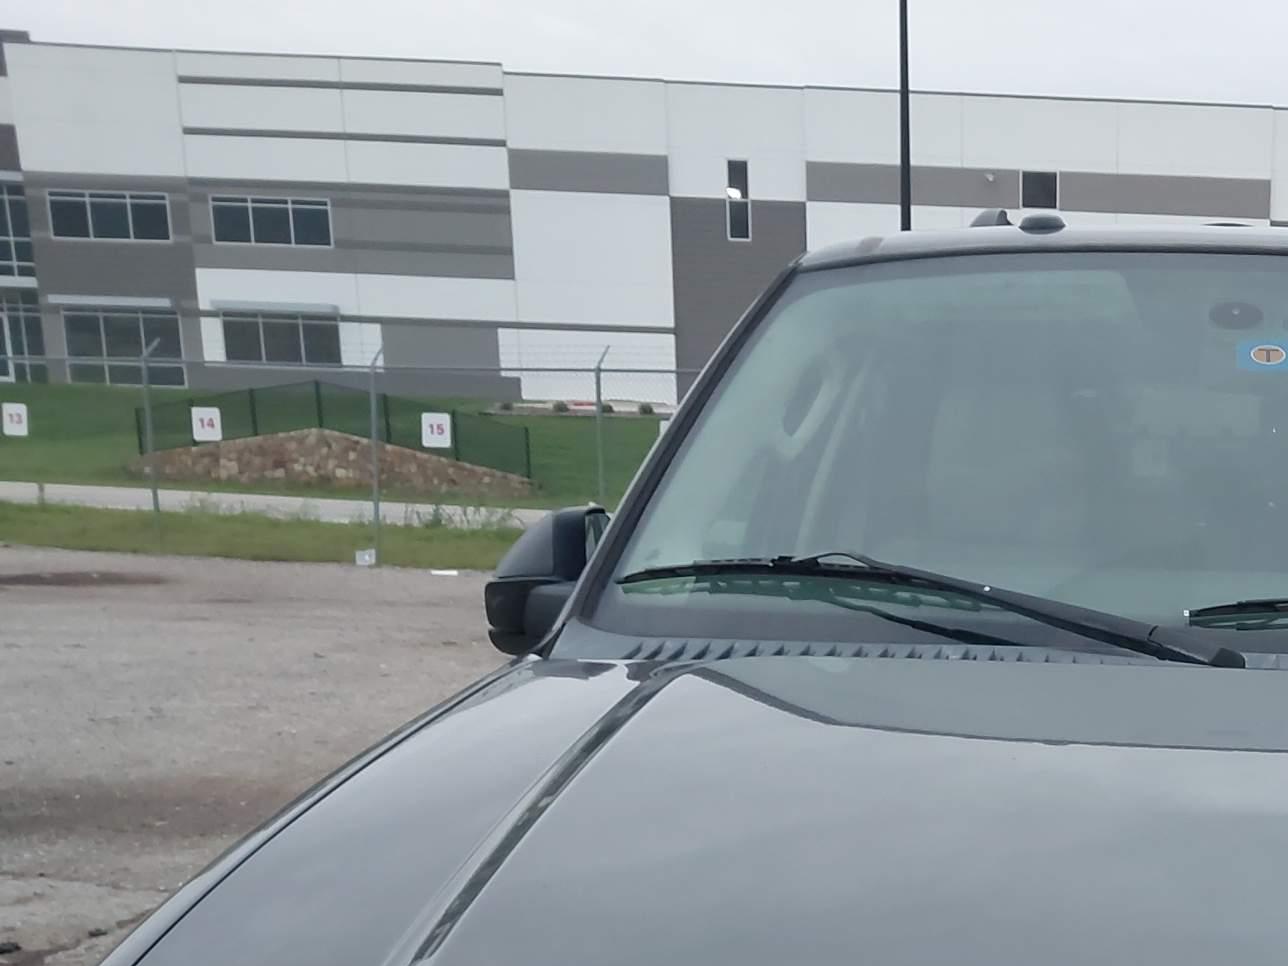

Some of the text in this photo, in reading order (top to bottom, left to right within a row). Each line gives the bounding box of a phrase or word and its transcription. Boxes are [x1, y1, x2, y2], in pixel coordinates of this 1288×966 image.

[8, 412, 24, 425] 13
[199, 416, 215, 429] 14
[429, 423, 445, 436] 15
